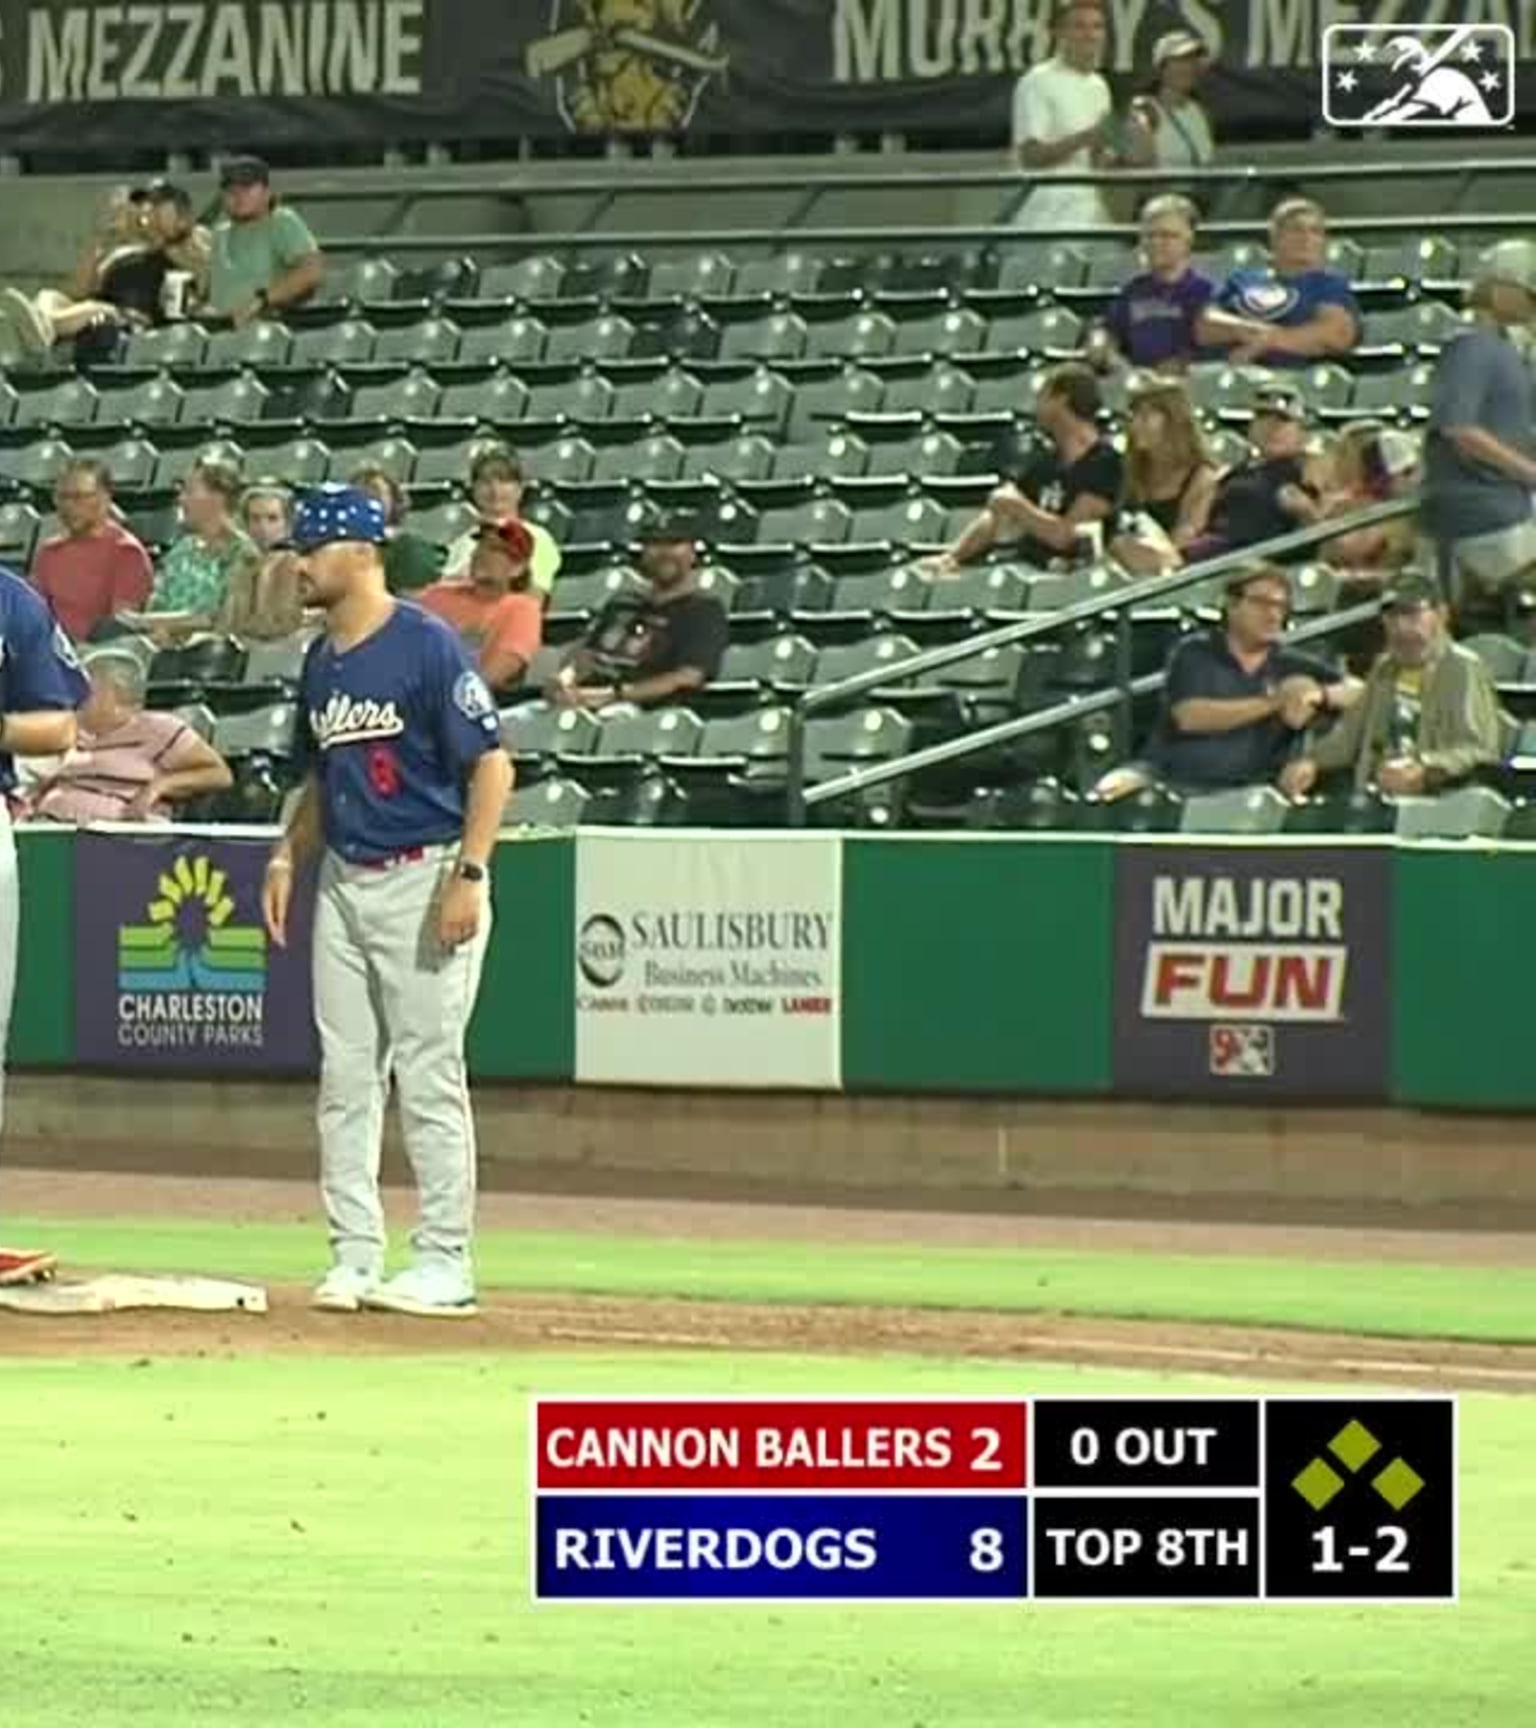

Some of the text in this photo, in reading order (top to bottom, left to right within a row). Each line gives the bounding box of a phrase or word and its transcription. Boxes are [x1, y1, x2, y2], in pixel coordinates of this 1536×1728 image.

[26, 1, 422, 104] MEZZANINE
[1153, 877, 1342, 937] MAJOR
[630, 911, 828, 950] SAULISBURY
[644, 959, 823, 988] Business Machines
[1154, 954, 1332, 1010] FUN
[118, 993, 263, 1021] CHARLESTON
[118, 1021, 264, 1047] COUNTY PARKS
